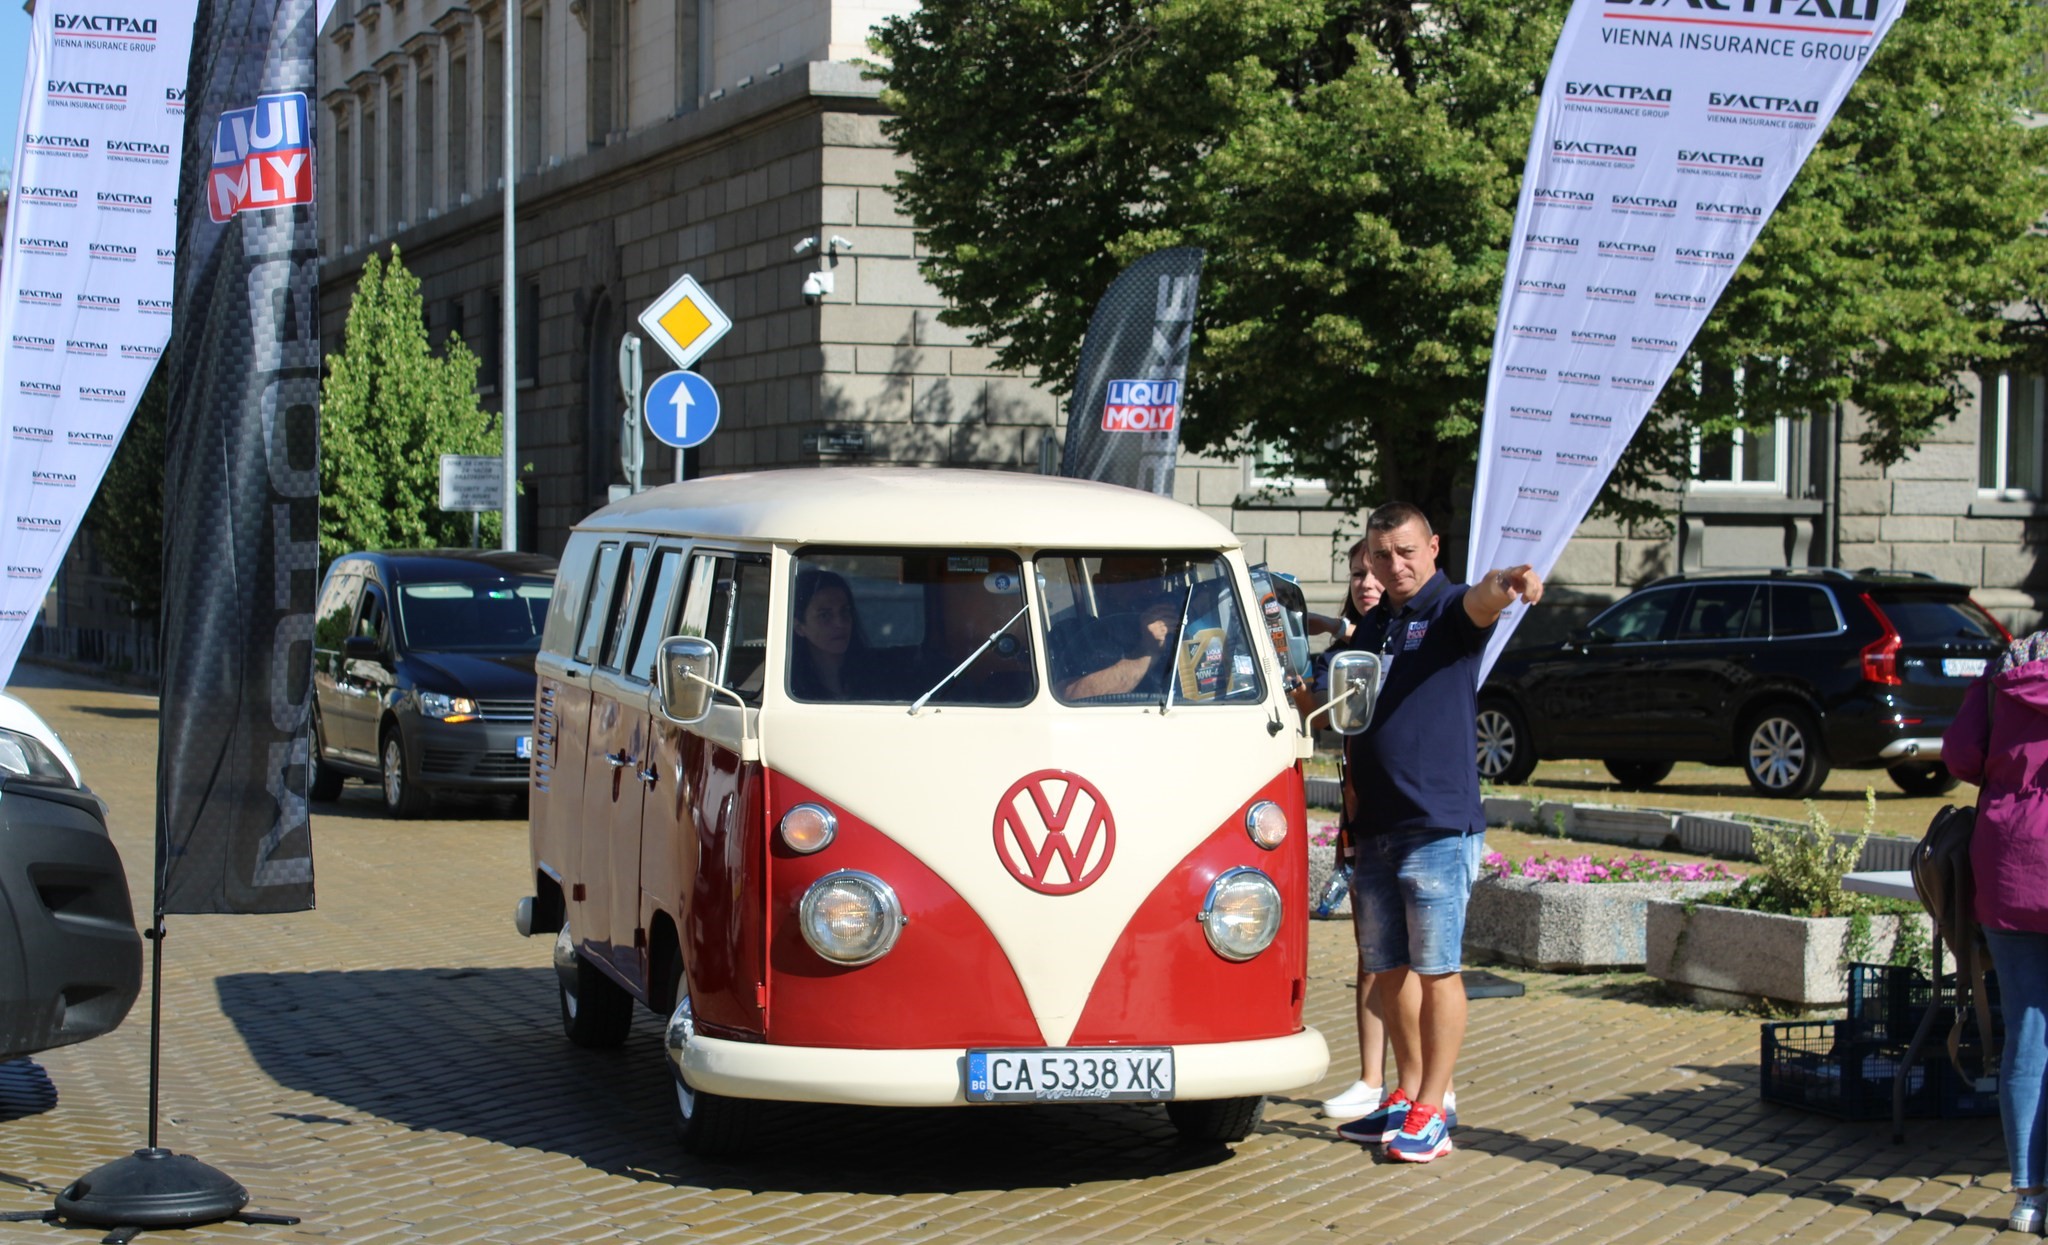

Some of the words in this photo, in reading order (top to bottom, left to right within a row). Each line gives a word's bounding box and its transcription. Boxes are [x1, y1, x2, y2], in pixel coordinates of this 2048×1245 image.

[54, 13, 157, 34] БУЛСТРАД
[54, 38, 81, 48] VIENNA
[84, 39, 127, 51] INSURANCE
[129, 42, 156, 53] GROUP
[1602, 27, 1673, 48] VIENNA
[1679, 32, 1794, 57] INSURANCE
[1801, 40, 1870, 62] GROUP
[48, 80, 127, 96] БУЛСТРАД
[1565, 81, 1672, 102] БУЛСТРАД
[48, 99, 69, 108] VIENNA
[71, 100, 104, 110] INSURANCE
[106, 102, 126, 112] GROUP
[1564, 103, 1592, 113] VIENNA
[1594, 105, 1639, 117] INSURANCE
[1642, 108, 1669, 119] GROUP
[1709, 91, 1819, 114] БУЛСТРАД
[1708, 114, 1736, 124] VIENNA
[1739, 116, 1785, 128] INSURANCE
[1788, 120, 1816, 131] GROUP
[214, 101, 300, 164] LIUI
[1553, 139, 1637, 157] БУЛСТРАД
[1552, 157, 1574, 165] VIENNA
[1576, 159, 1611, 168] INSURANCE
[1614, 162, 1634, 170] GROUP
[1678, 149, 1764, 167] БУЛСТРАД
[1677, 167, 1699, 175] VIENNA
[1701, 169, 1738, 179] INSURANCE
[1740, 172, 1761, 181] GROUP
[215, 154, 307, 215] MLY
[138, 299, 172, 308] БУЛСТР
[1110, 382, 1172, 406] LIQUI
[1107, 407, 1172, 428] MOLY
[1196, 668, 1220, 680] 10W-4
[972, 1082, 986, 1091] BG
[993, 1059, 1034, 1090] CA
[1042, 1059, 1118, 1090] 5338
[1127, 1058, 1165, 1090] XK
